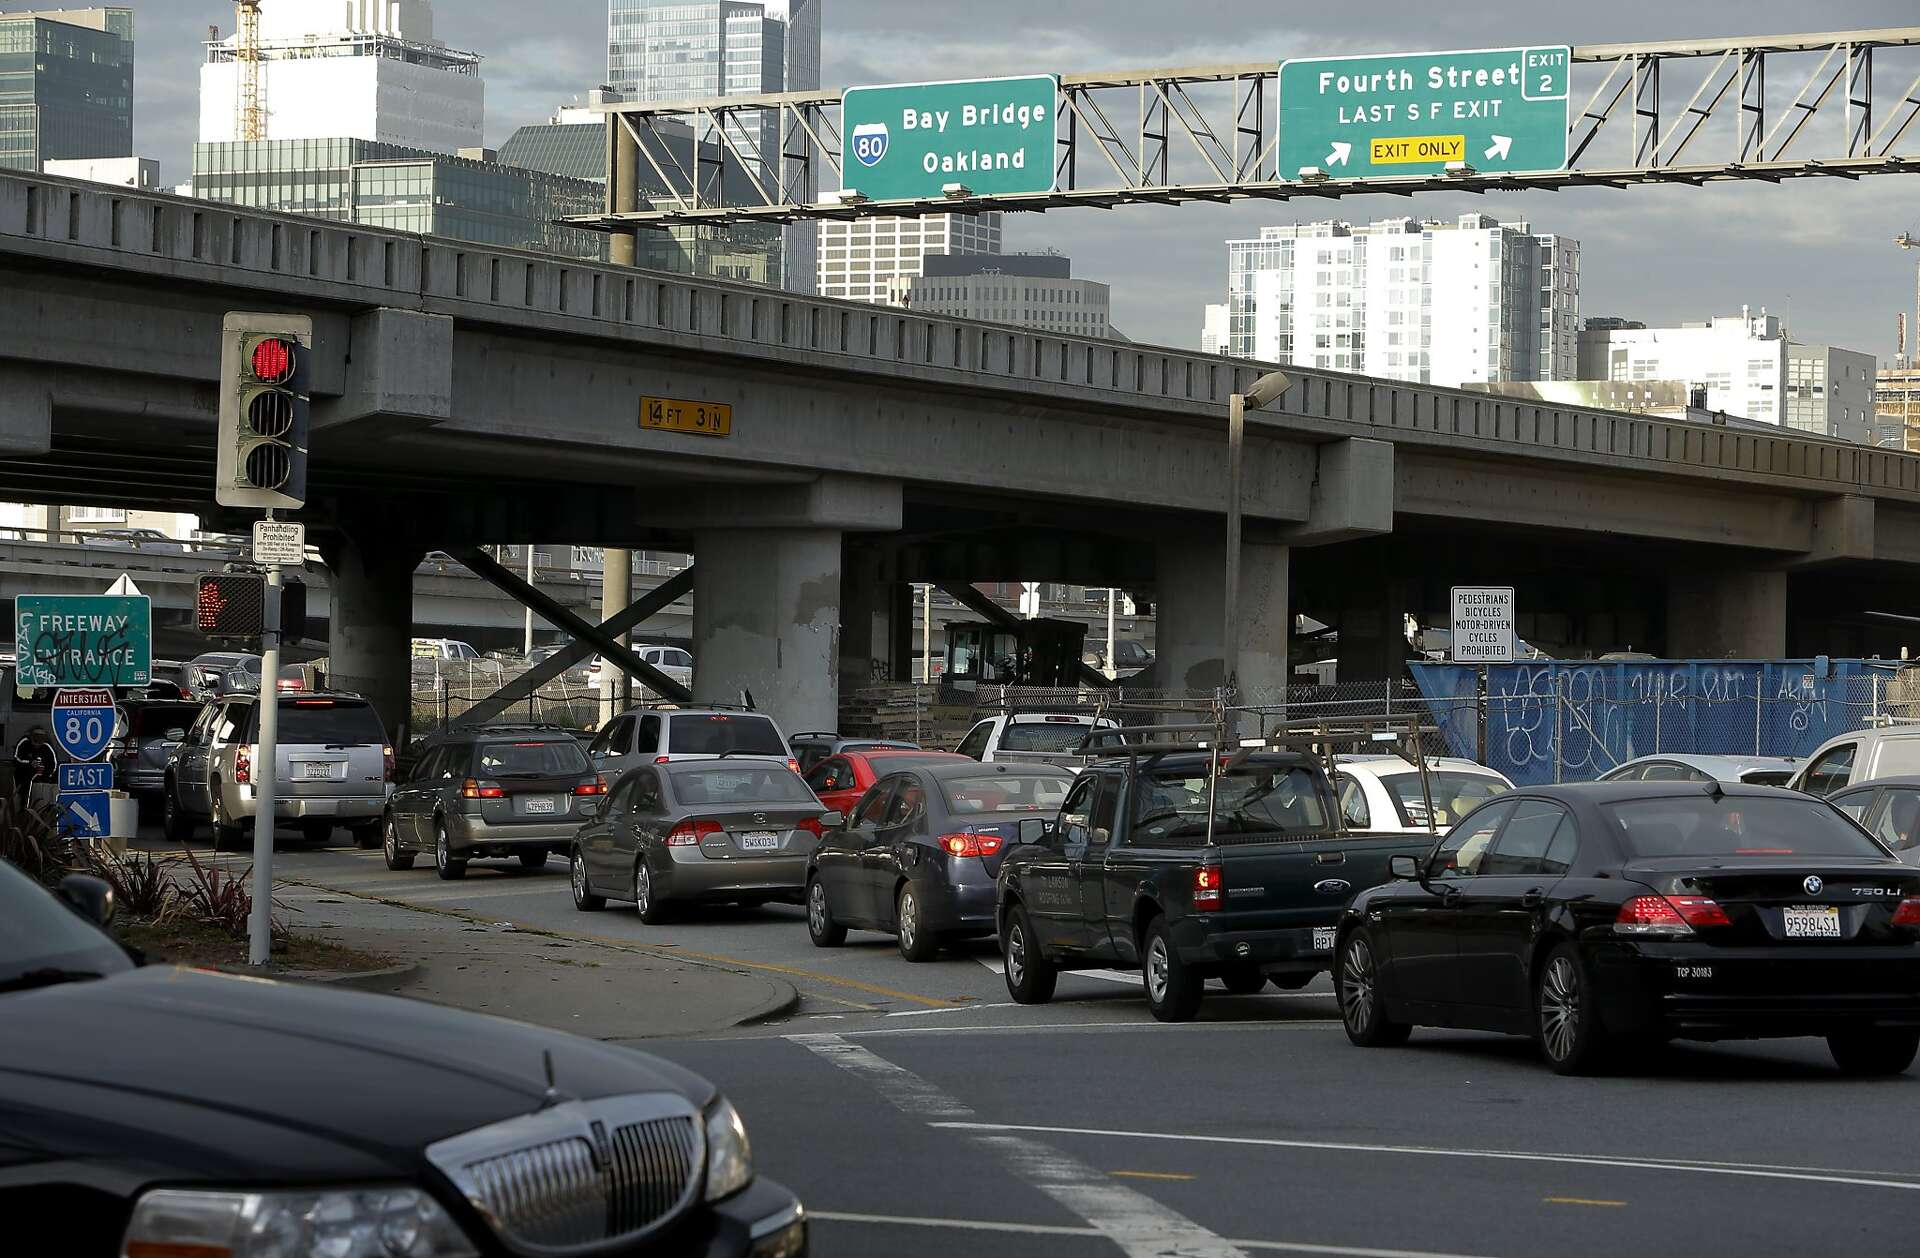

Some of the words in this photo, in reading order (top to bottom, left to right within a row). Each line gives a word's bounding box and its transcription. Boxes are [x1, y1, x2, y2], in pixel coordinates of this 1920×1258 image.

[1528, 53, 1564, 67] EXIT
[1318, 69, 1414, 95] Fourth
[1427, 63, 1520, 89] Street
[1539, 74, 1553, 92] 2
[903, 108, 950, 133] Bay
[962, 102, 1045, 129] Bridge
[1338, 104, 1396, 124] LAST
[1407, 103, 1420, 121] S
[1430, 102, 1443, 120] F
[1453, 100, 1503, 119] EXIT
[858, 136, 883, 158] 80
[1373, 143, 1410, 158] EXIT
[1418, 141, 1461, 156] ONLY
[923, 147, 1025, 173] Oakland
[648, 403, 662, 422] 14
[666, 408, 682, 425] FT
[696, 407, 705, 426] 3
[708, 412, 721, 428] IN
[260, 524, 299, 535] Panhandling
[263, 533, 295, 541] Prohibited
[1458, 594, 1509, 605] PEDESTRIANS
[1465, 607, 1502, 617] BICYCLES
[39, 615, 128, 632] FREEWAY
[1455, 620, 1511, 630] MOTOR-DRIVEN
[1469, 632, 1497, 643] CYCLES
[33, 648, 136, 666] ENTRANCE
[1461, 646, 1506, 656] PROHIBITED
[60, 693, 108, 705] INTERSTATE
[66, 709, 102, 717] CALIFORNIA
[65, 717, 103, 744] 80
[67, 768, 105, 786] EAST
[1786, 917, 1838, 932] 95984S1
